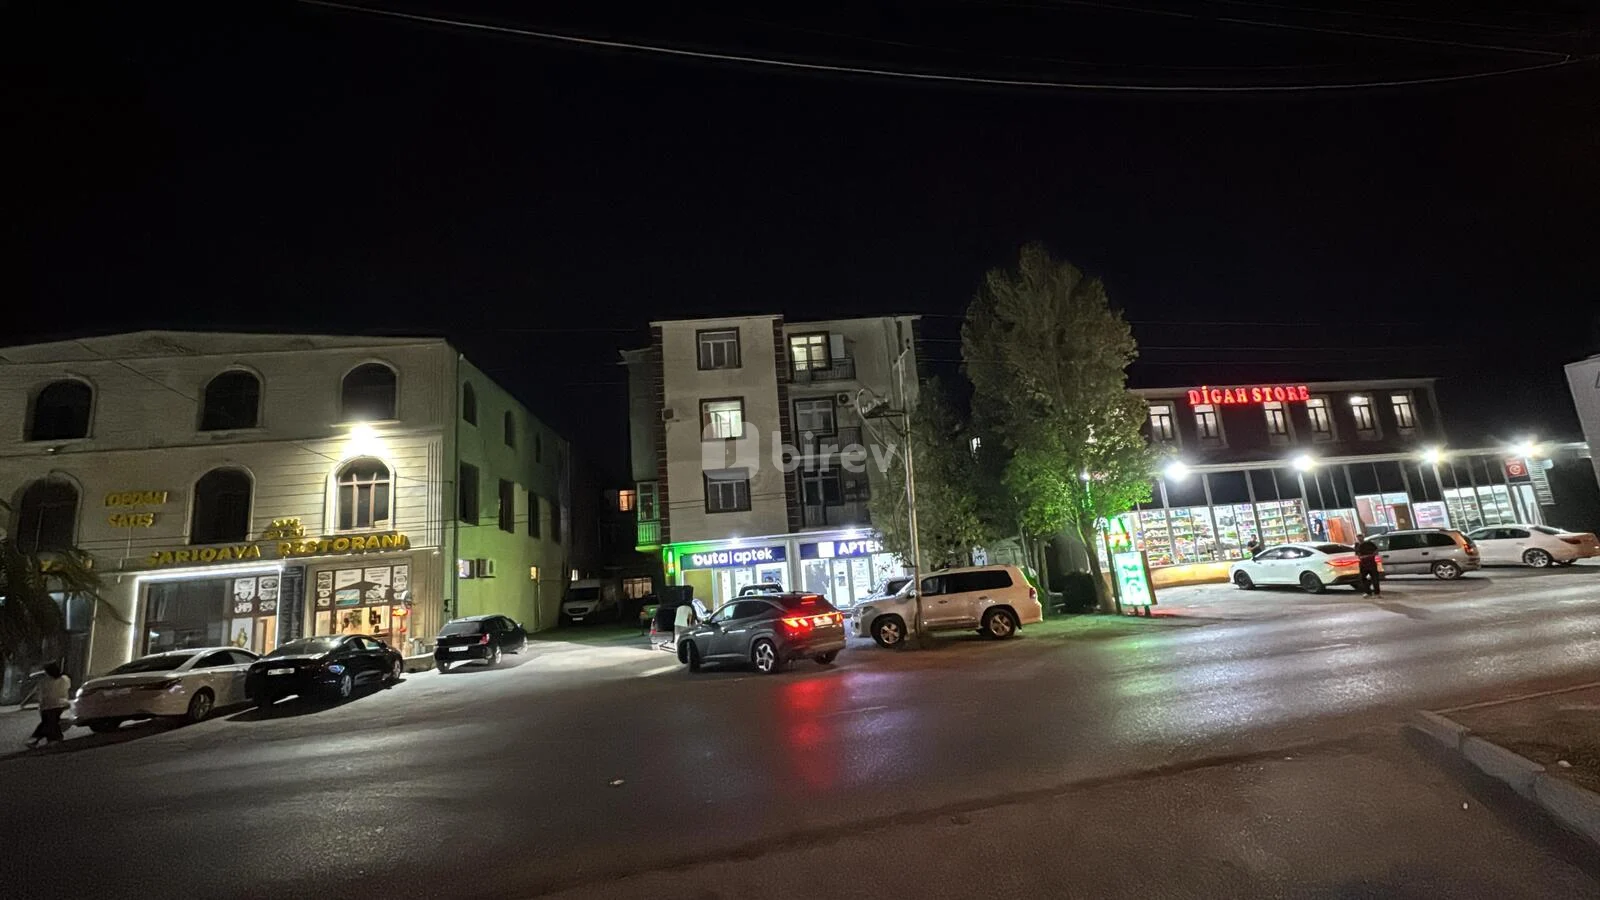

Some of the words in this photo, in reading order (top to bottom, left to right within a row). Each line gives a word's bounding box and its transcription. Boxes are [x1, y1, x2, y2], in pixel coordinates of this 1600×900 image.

[1187, 385, 1248, 405] DİGAH
[1251, 385, 1310, 402] STORE
[692, 552, 728, 566] buta
[734, 547, 773, 565] aptek
